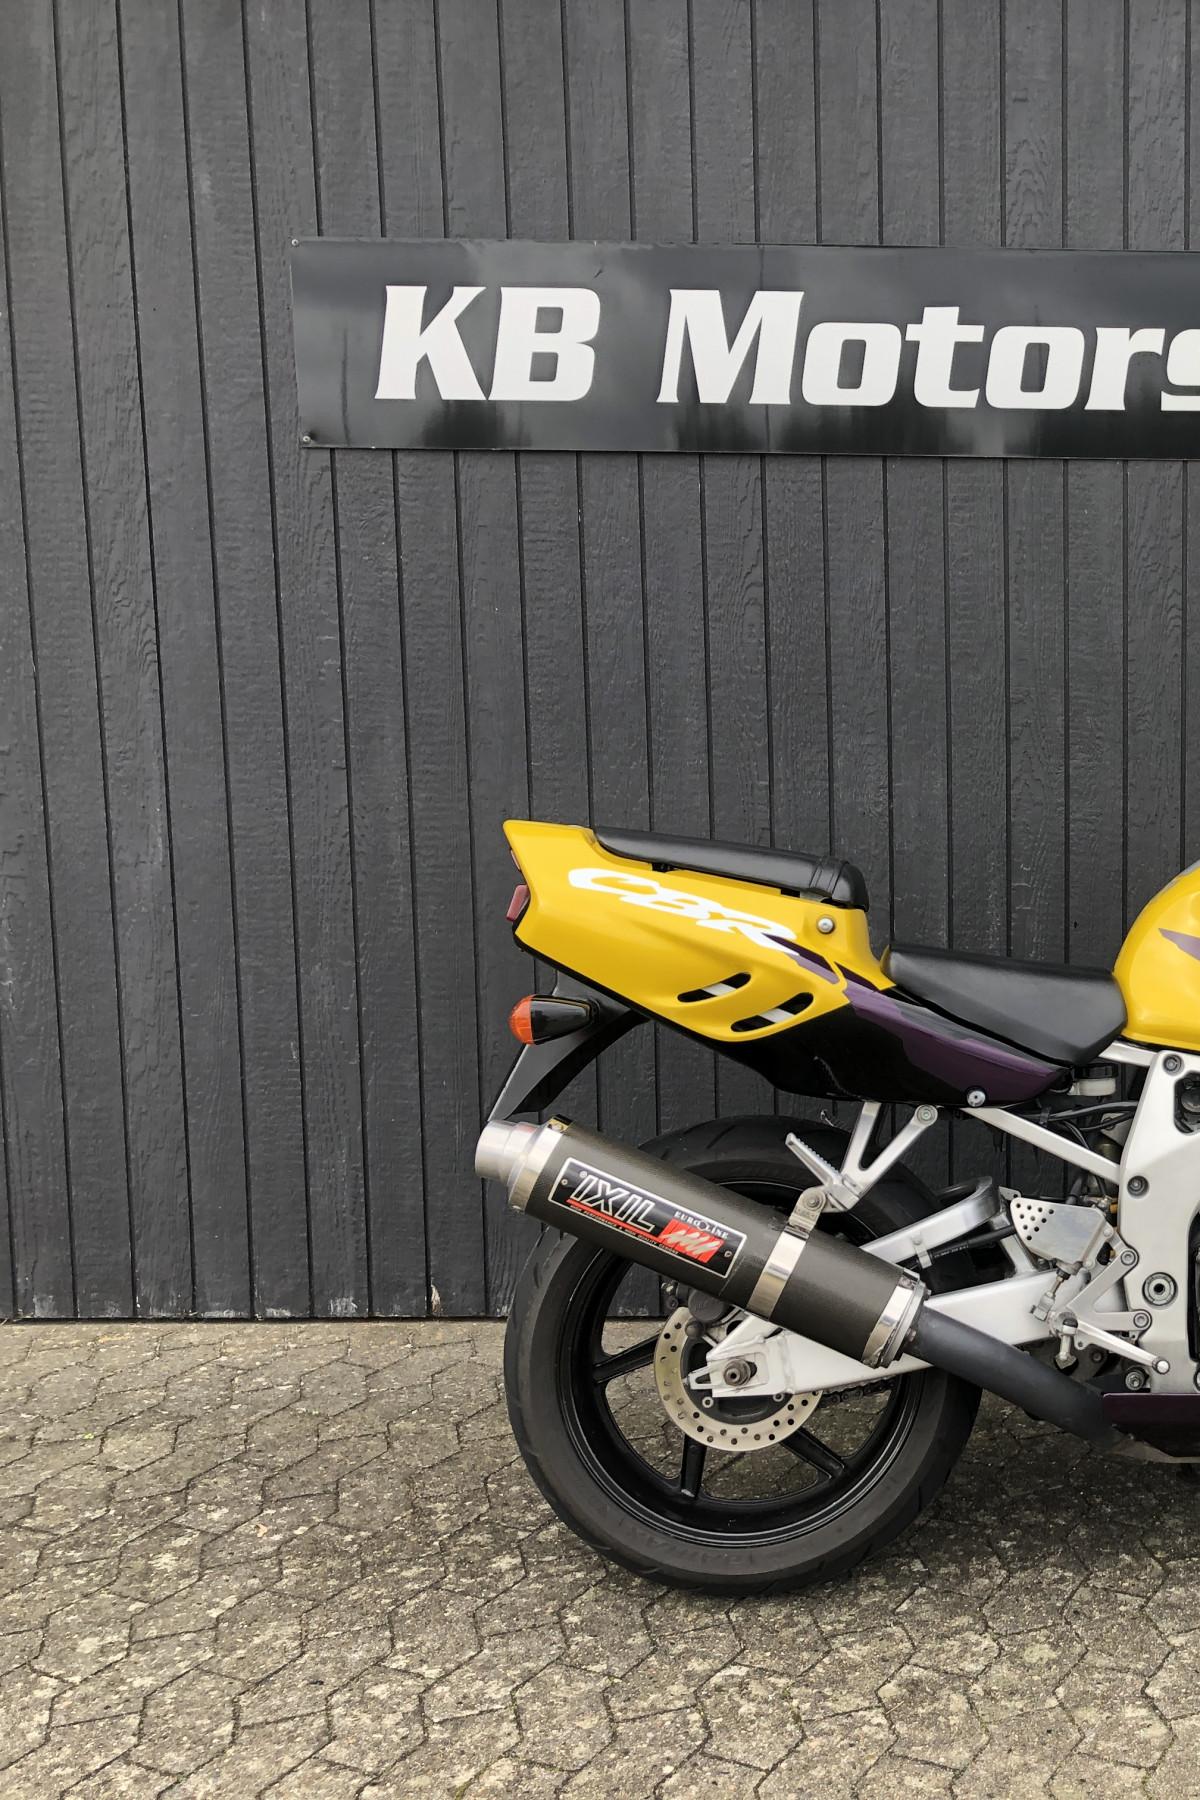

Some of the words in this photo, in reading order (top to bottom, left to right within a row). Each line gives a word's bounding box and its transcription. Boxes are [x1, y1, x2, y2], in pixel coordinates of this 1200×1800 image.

[374, 285, 601, 402] KB
[568, 868, 800, 956] CBR
[570, 1174, 656, 1232] IXIL
